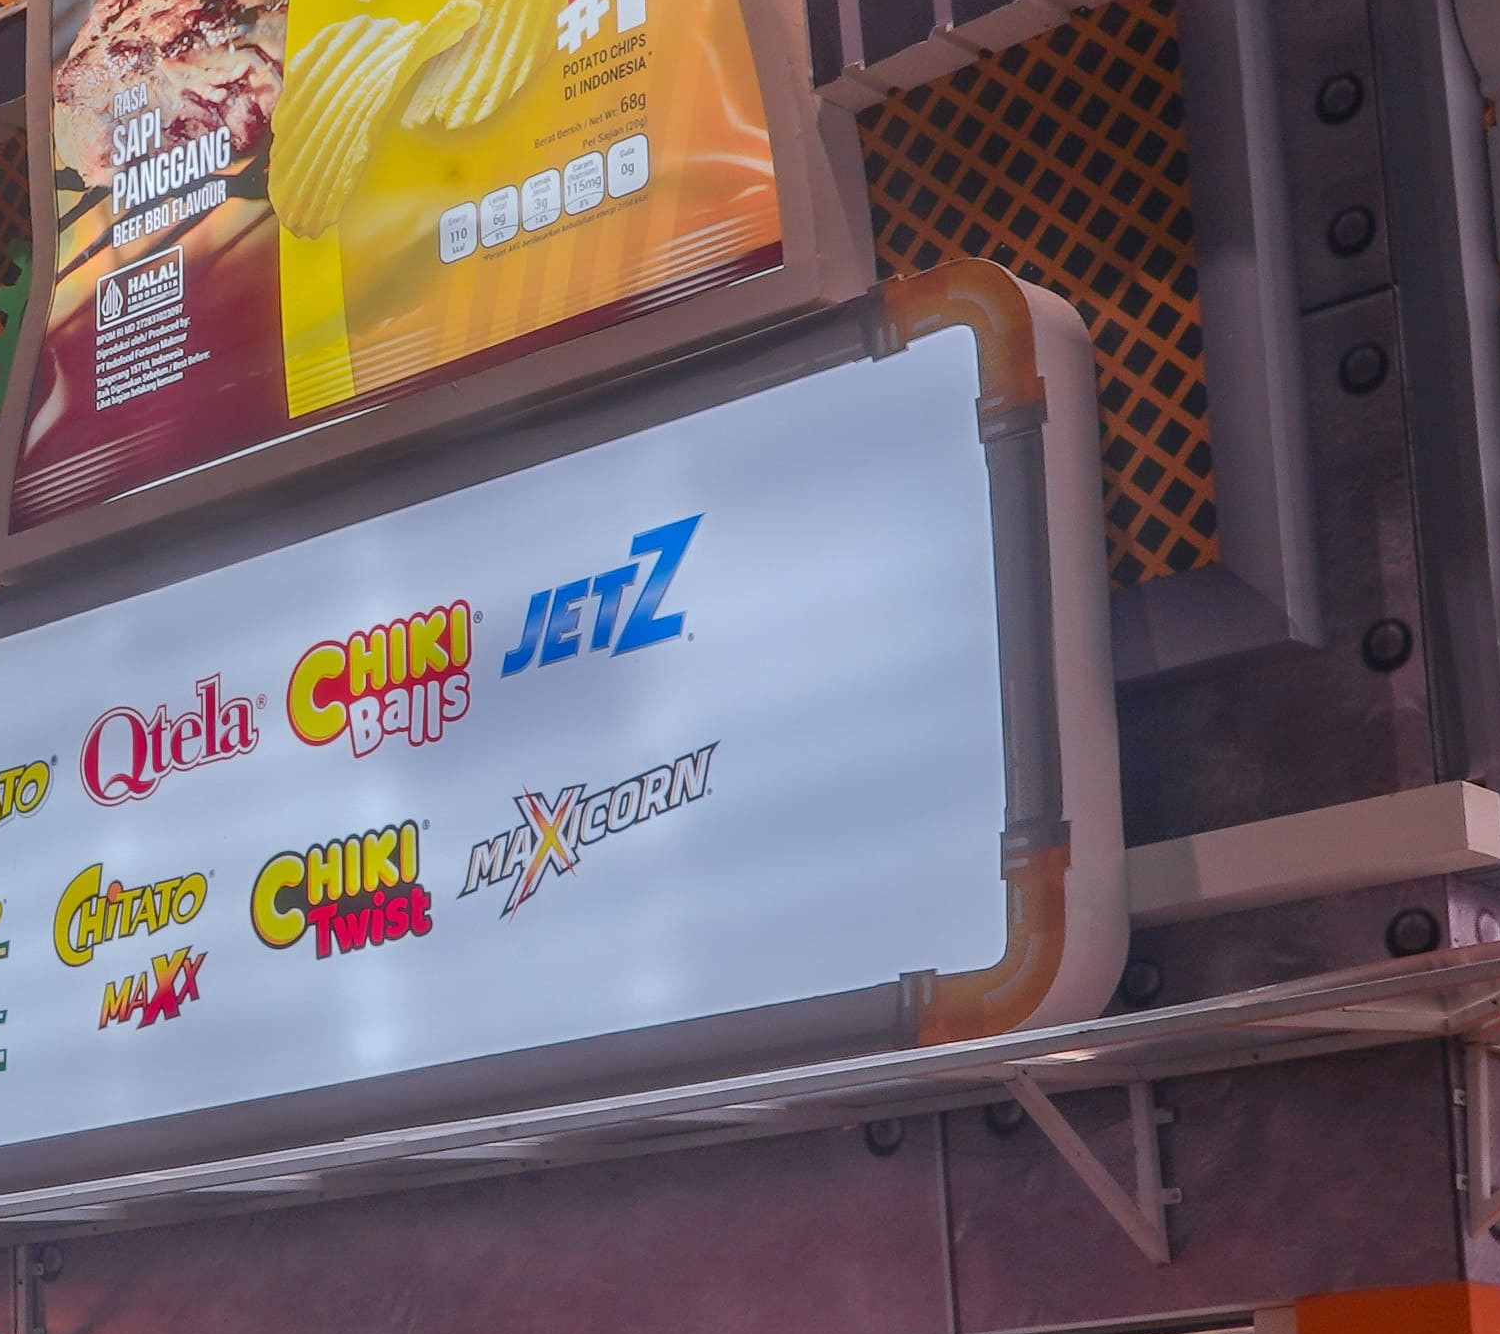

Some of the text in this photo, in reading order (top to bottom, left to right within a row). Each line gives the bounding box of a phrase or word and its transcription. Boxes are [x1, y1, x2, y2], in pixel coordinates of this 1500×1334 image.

[563, 33, 647, 79] POTATO CHIPS
[113, 81, 149, 119] RASA
[564, 82, 578, 101] DI
[620, 91, 647, 114] 68g
[112, 107, 162, 167] SAPI
[112, 125, 231, 215] PANGGANG
[112, 179, 227, 249] BEEF BBQ FLAVOUR
[127, 261, 179, 296] HALAL
[500, 512, 704, 679] JETZ
[287, 599, 473, 748] CHIKI
[79, 672, 261, 807] Qtela
[348, 670, 472, 759] Balls
[250, 819, 421, 950] CHIKI
